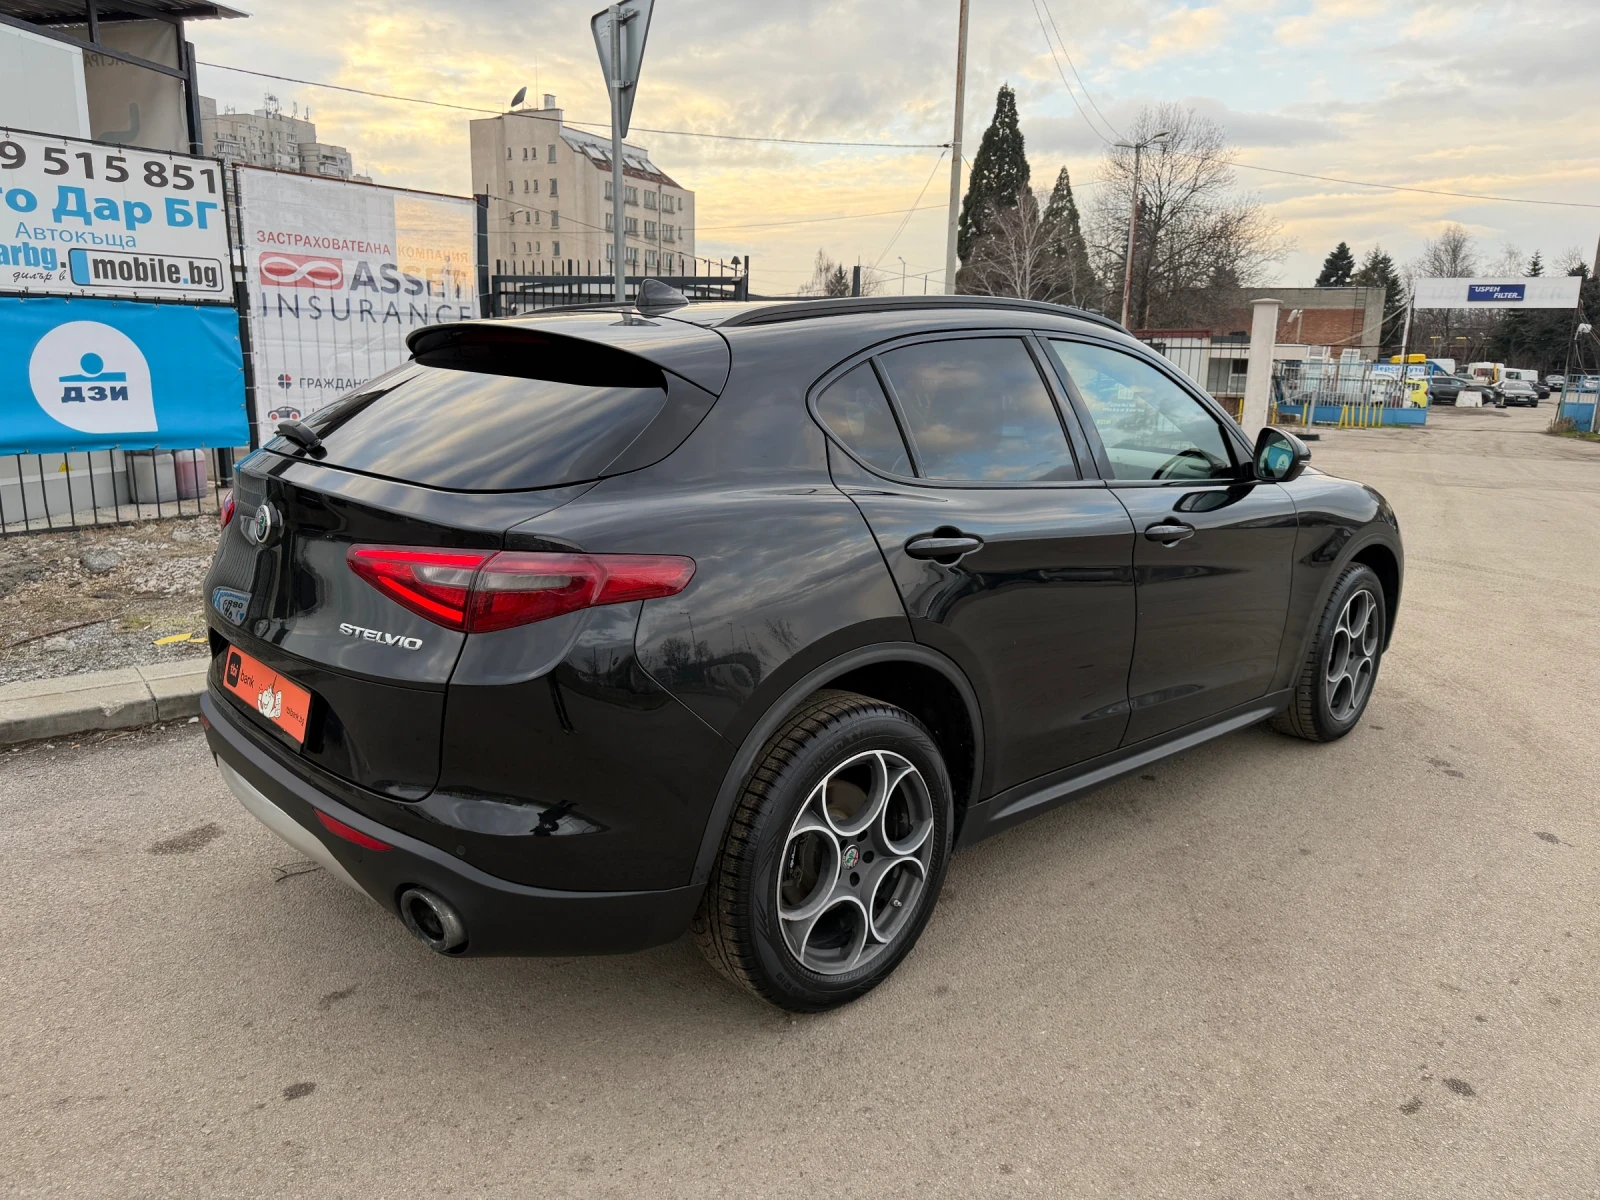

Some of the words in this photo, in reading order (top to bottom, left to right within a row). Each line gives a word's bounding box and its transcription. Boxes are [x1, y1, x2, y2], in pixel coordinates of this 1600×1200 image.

[43, 146, 130, 182] 515
[143, 161, 216, 194] 851
[0, 186, 38, 213] о
[52, 185, 153, 231] Дар
[164, 197, 218, 229] БГ
[15, 221, 137, 250] Автокъща
[256, 230, 391, 256] ЗАСТРАХОВАТЕЛНА
[398, 245, 469, 264] КОМПАНИЯ
[92, 257, 218, 288] mobile.bg
[350, 261, 466, 299] ASSET
[261, 292, 472, 325] INSURANCE
[61, 385, 129, 403] ДЗИ
[339, 622, 424, 651] STELVIO
[240, 669, 255, 689] bank
